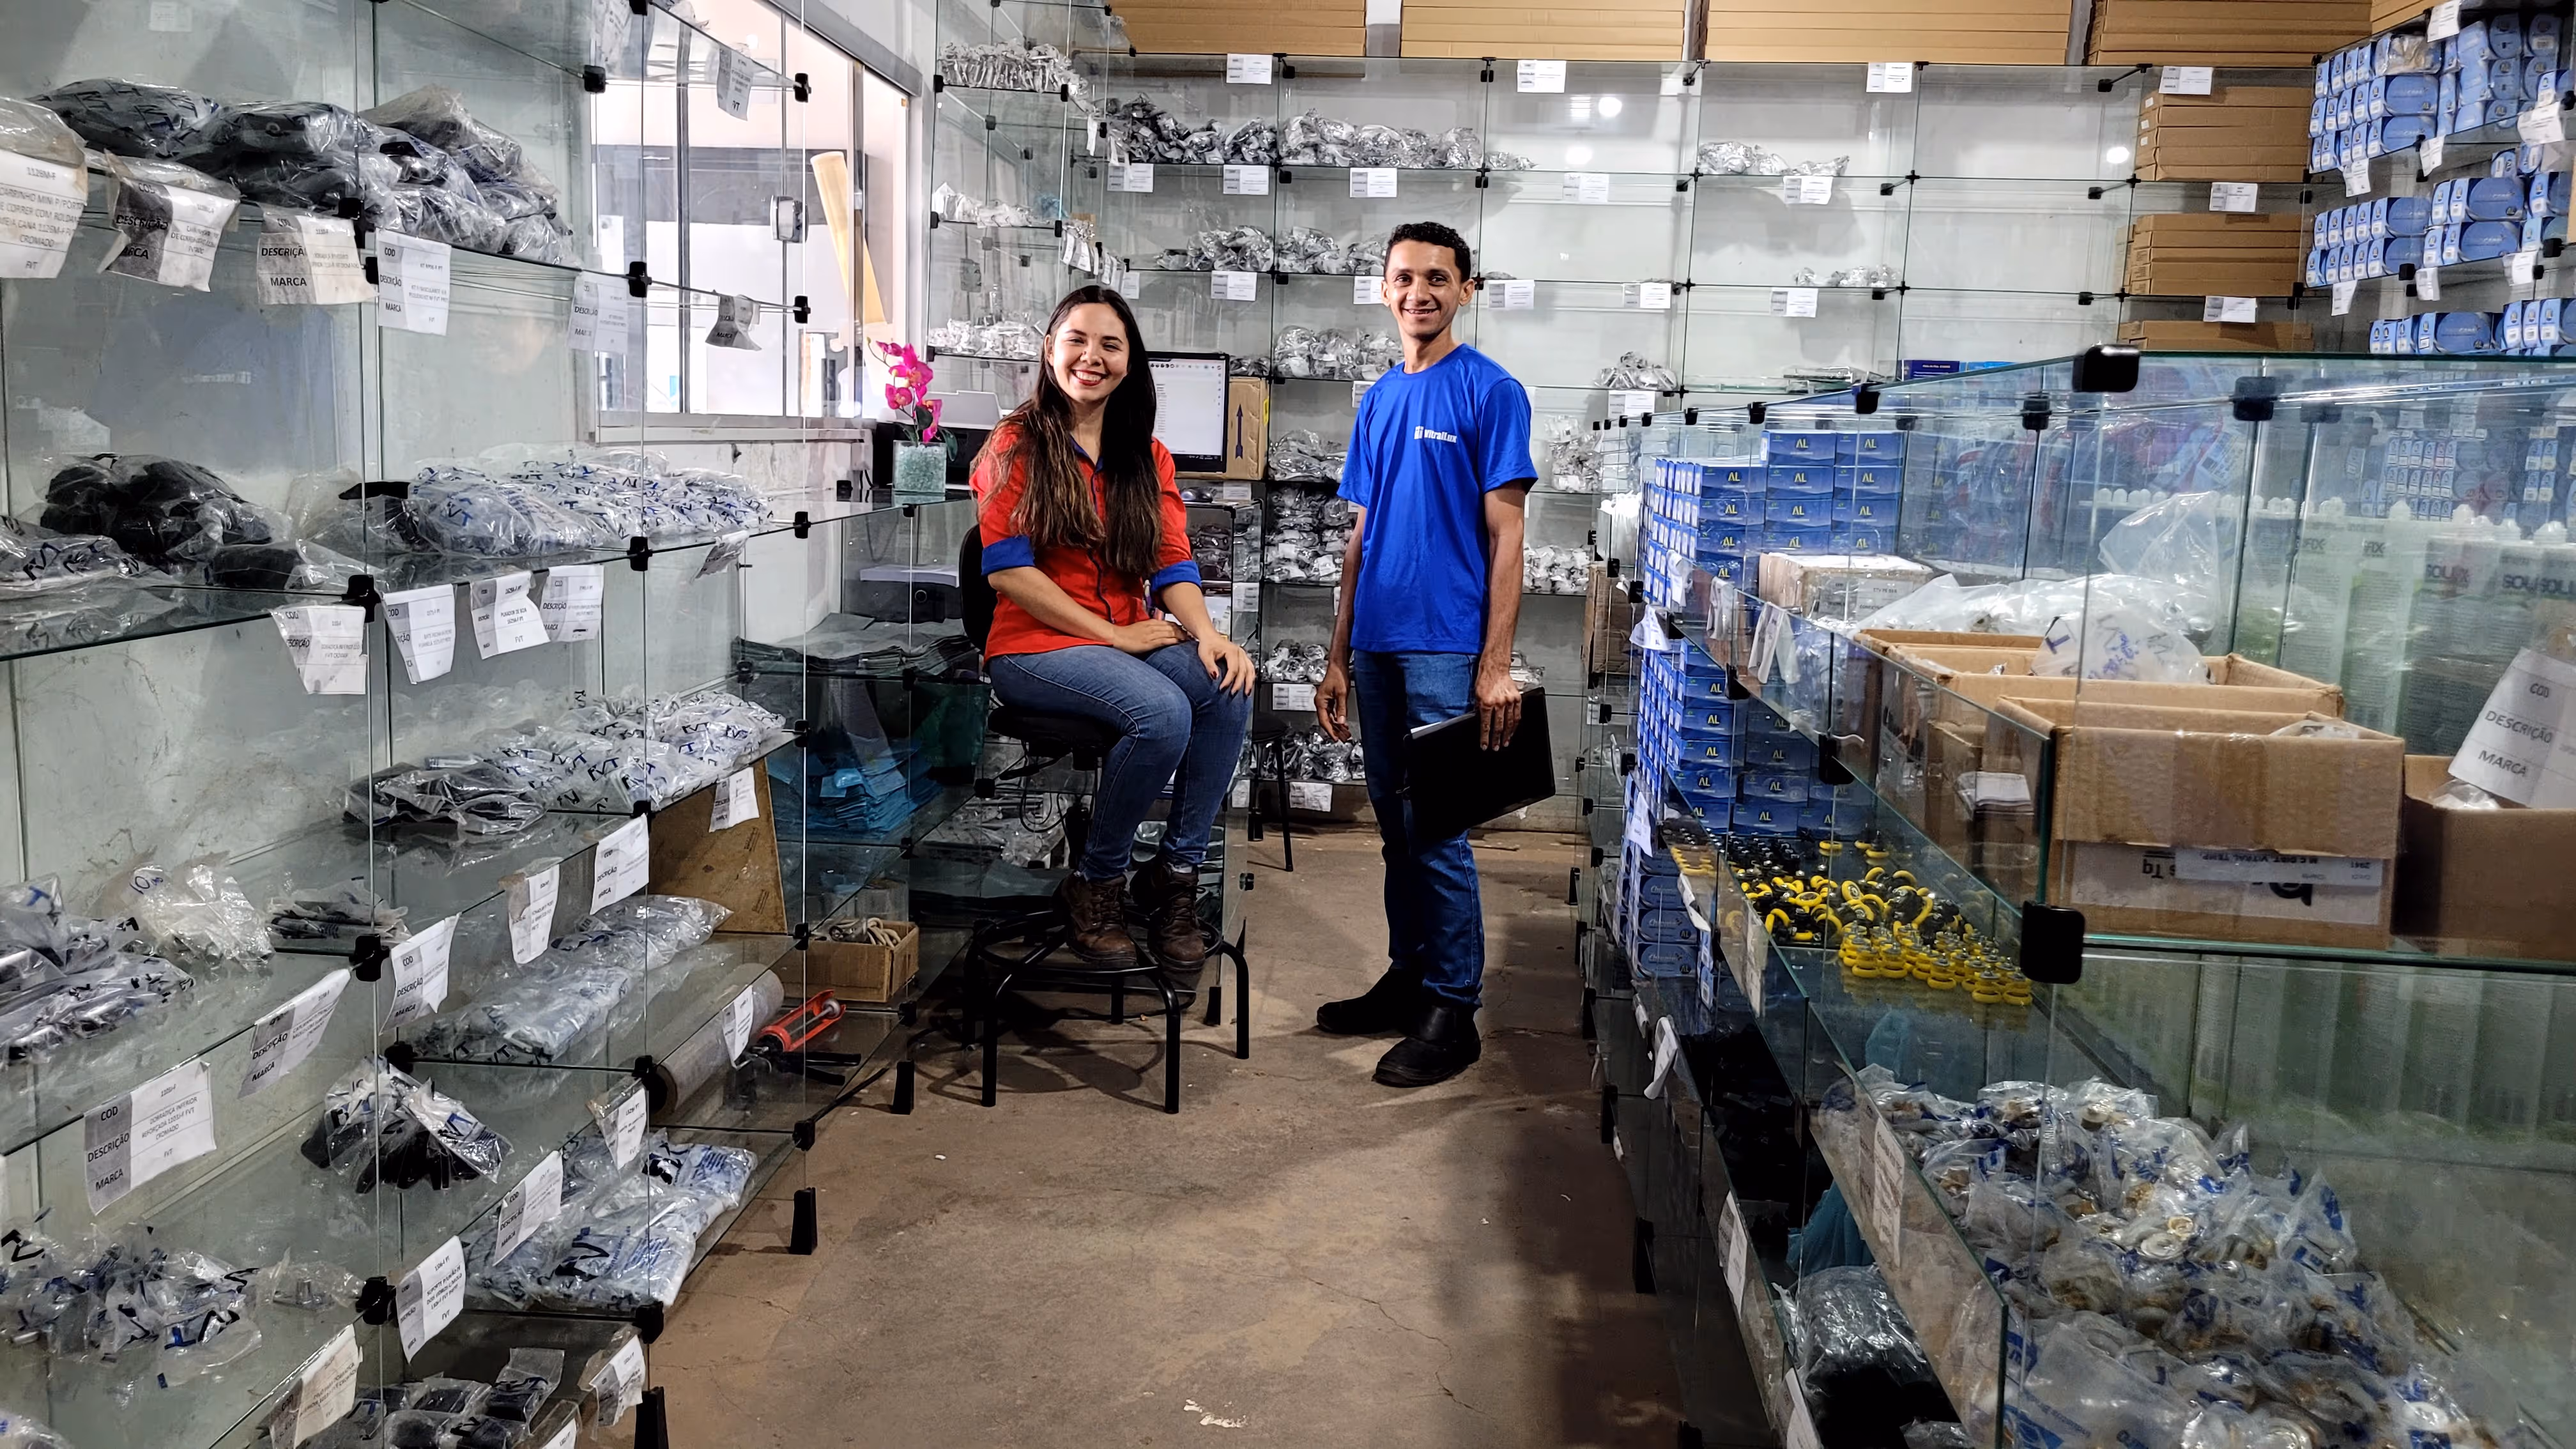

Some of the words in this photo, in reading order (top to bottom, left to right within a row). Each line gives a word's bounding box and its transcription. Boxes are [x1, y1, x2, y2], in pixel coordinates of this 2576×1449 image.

[38, 195, 52, 206] MINI
[6, 203, 33, 215] CORRER
[35, 209, 52, 219] COM
[18, 220, 36, 231] CANA
[116, 215, 168, 230] DESCRIÇÃO
[20, 234, 55, 248] CROMADO
[121, 245, 149, 259] ARCA
[261, 245, 307, 258] DESCRIÇÃ
[385, 247, 395, 257] COD
[26, 261, 38, 269] FVT
[270, 277, 307, 286] MARCA
[379, 274, 402, 288] DESCRIÇÃO
[385, 302, 401, 312] MARCA
[1796, 439, 1809, 448] AL
[1864, 439, 1877, 448] AL
[1728, 471, 1740, 482] AL
[1794, 473, 1807, 482] AL
[1862, 473, 1874, 482] AL
[1725, 504, 1738, 514] AL
[1792, 505, 1805, 516] AL
[1859, 506, 1872, 516] AL
[1722, 537, 1735, 546] AL
[1789, 537, 1801, 548] AL
[1856, 538, 1868, 548] AL
[1718, 568, 1730, 578] AL
[543, 602, 567, 610] DESCRIÇÃO
[1710, 683, 1723, 693] AL
[2529, 683, 2550, 698] COD
[1707, 714, 1720, 724] AL
[2485, 710, 2553, 744] DESCRIÇÃO
[1706, 746, 1719, 756] AL
[1772, 749, 1784, 759] AL
[2478, 749, 2528, 777] MARCA
[588, 758, 619, 781] FVT
[1698, 777, 1711, 786] AL
[1770, 781, 1782, 791] AL
[1693, 807, 1705, 817] AL
[1759, 811, 1772, 821] AL
[597, 866, 617, 882] DESCRIÇÃO
[403, 956, 413, 967] COD
[397, 977, 423, 997] DESCRIÇÃO
[395, 1004, 416, 1017] MARCA
[252, 1033, 288, 1060] DESCRIÇÃO
[252, 1061, 275, 1082] MARCA
[101, 1106, 118, 1121] COD
[150, 1107, 175, 1124] DOBRADIÇA
[176, 1096, 197, 1112] INFERIOR
[141, 1120, 167, 1138] REFORÇADA
[185, 1107, 195, 1116] FVT
[156, 1124, 179, 1140] CROMADO
[88, 1132, 129, 1162] DESCRIÇÃO
[164, 1148, 174, 1158] FVT
[95, 1169, 123, 1191] MARCA
[500, 1208, 524, 1230] DESCRIÇÃO
[501, 1230, 516, 1248] MARCA
